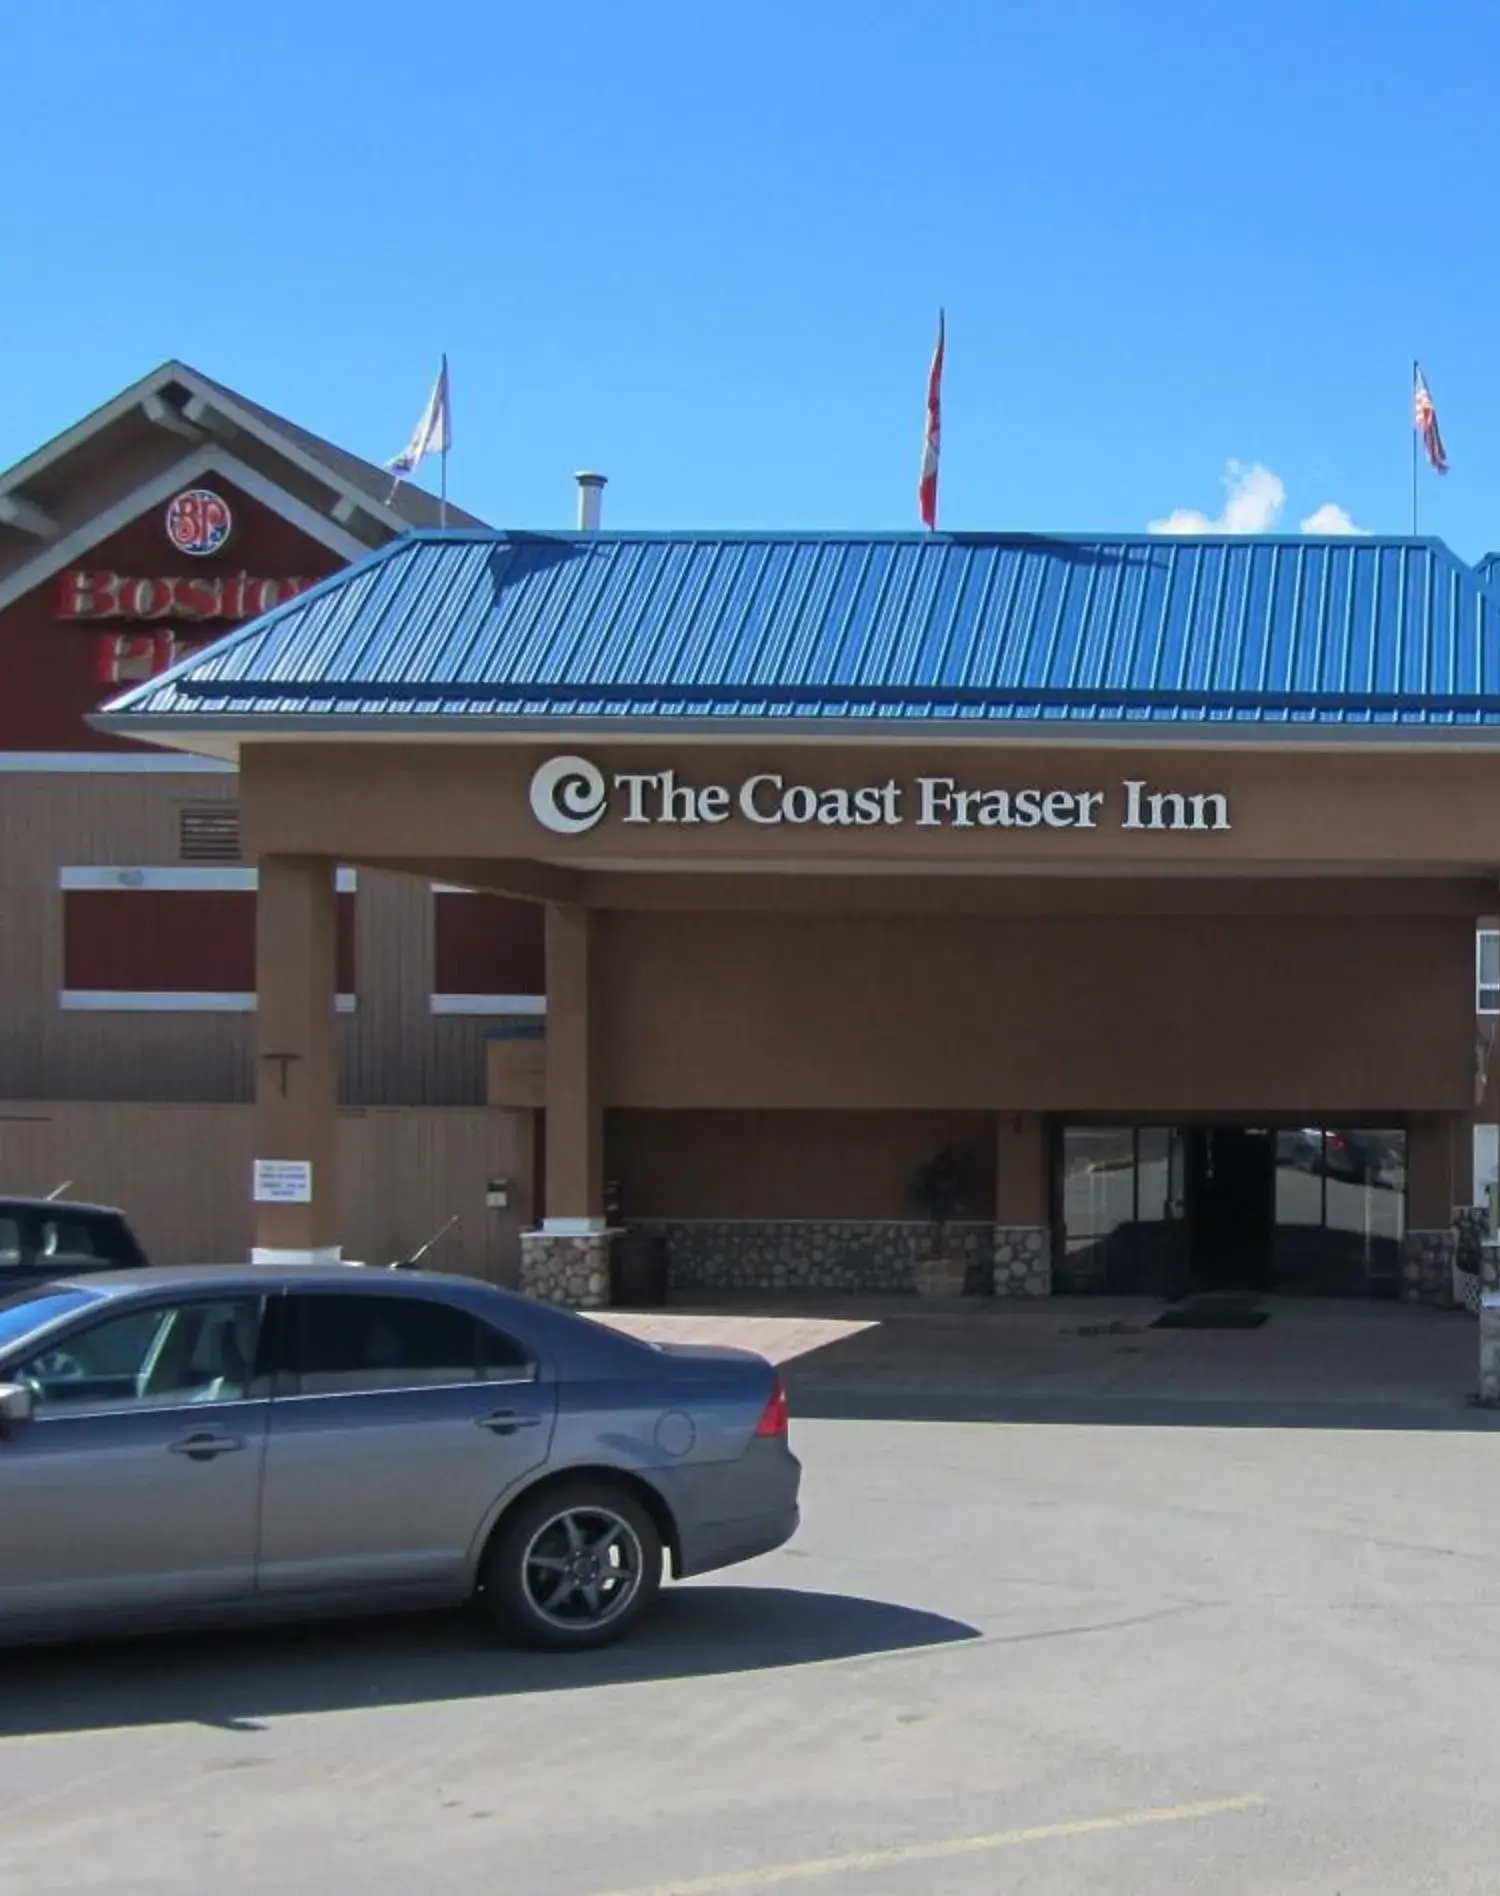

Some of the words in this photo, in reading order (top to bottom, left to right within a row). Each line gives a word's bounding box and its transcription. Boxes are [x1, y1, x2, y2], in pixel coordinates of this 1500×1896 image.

[613, 769, 731, 823] The
[739, 774, 903, 825] Coast
[915, 777, 1104, 827] Fraser
[1121, 779, 1232, 830] Inn
